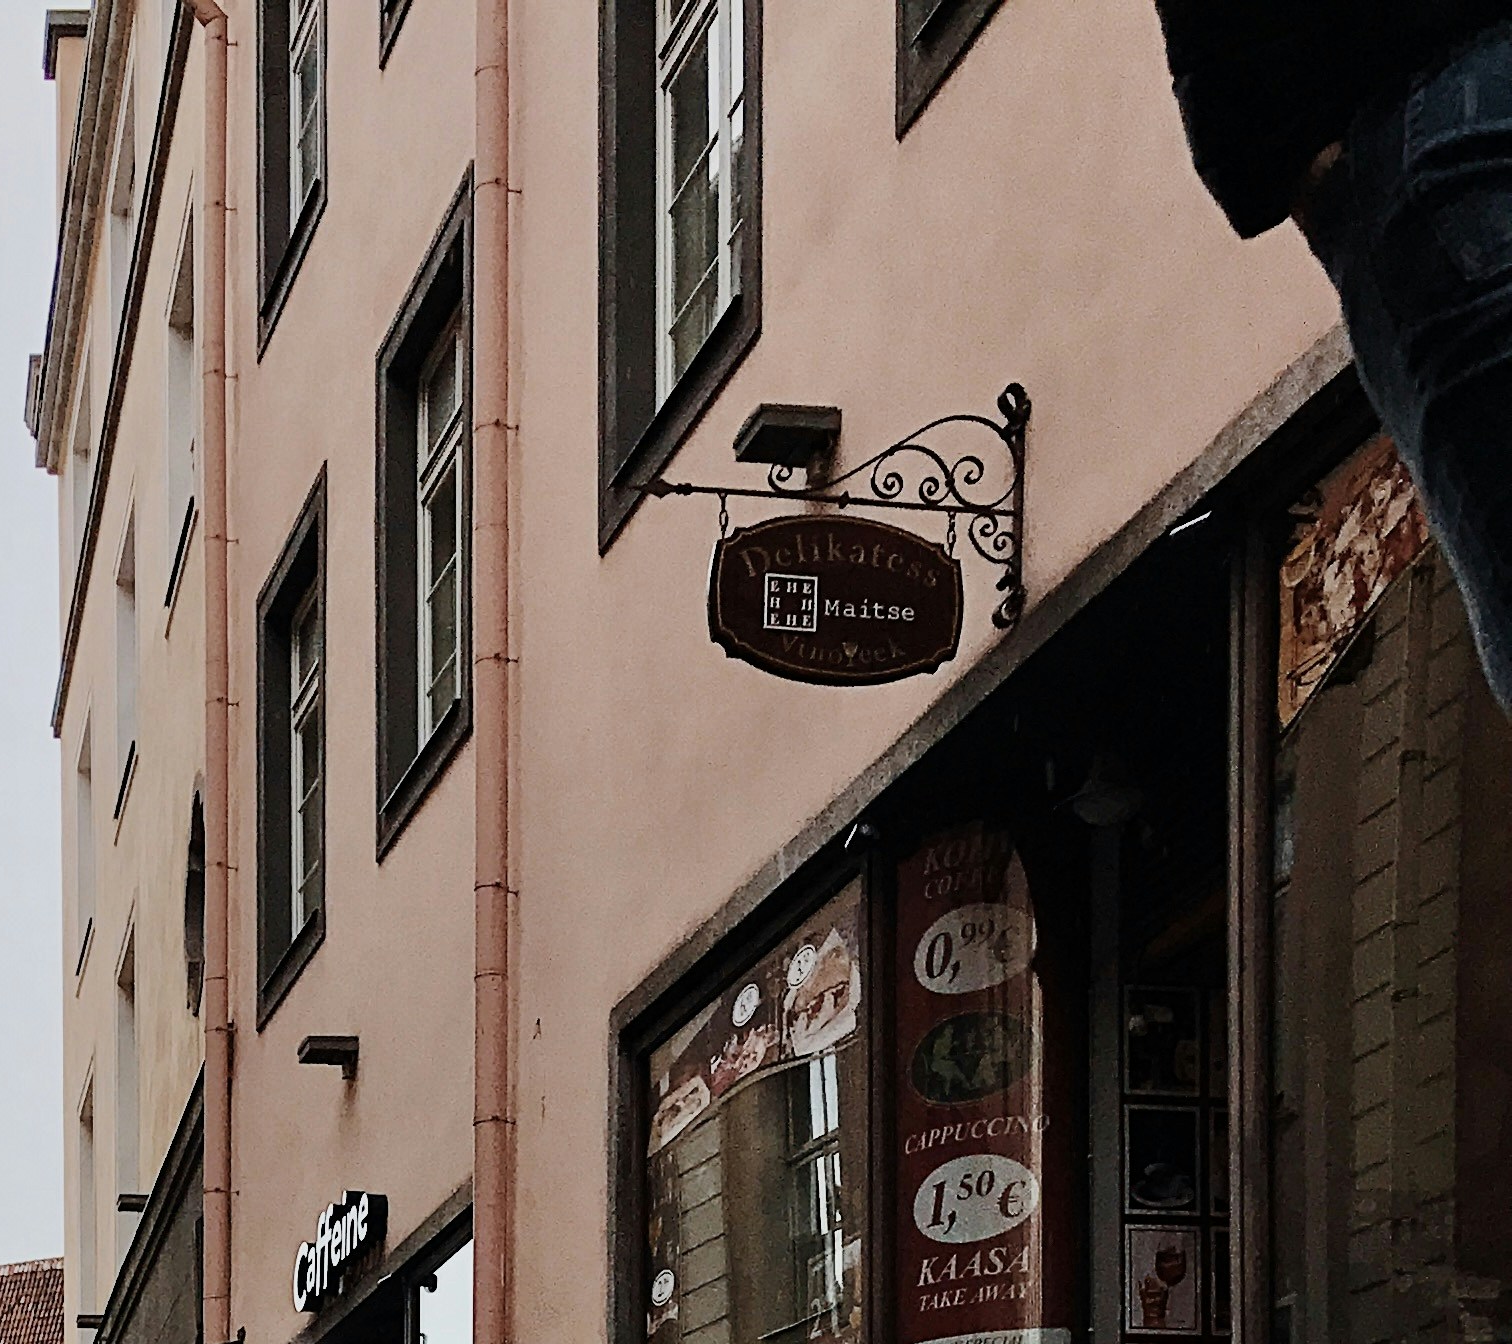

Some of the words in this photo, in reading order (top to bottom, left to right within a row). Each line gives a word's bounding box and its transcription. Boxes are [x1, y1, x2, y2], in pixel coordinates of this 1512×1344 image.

[739, 533, 940, 588] Delikatess
[824, 598, 916, 622] Maitse
[905, 1115, 1050, 1155] CAPPUCCINO
[293, 1189, 369, 1313] Caffeine
[917, 1245, 1030, 1287] KAASA
[919, 1287, 968, 1312] TAKE
[970, 1283, 1029, 1305] AWAY
